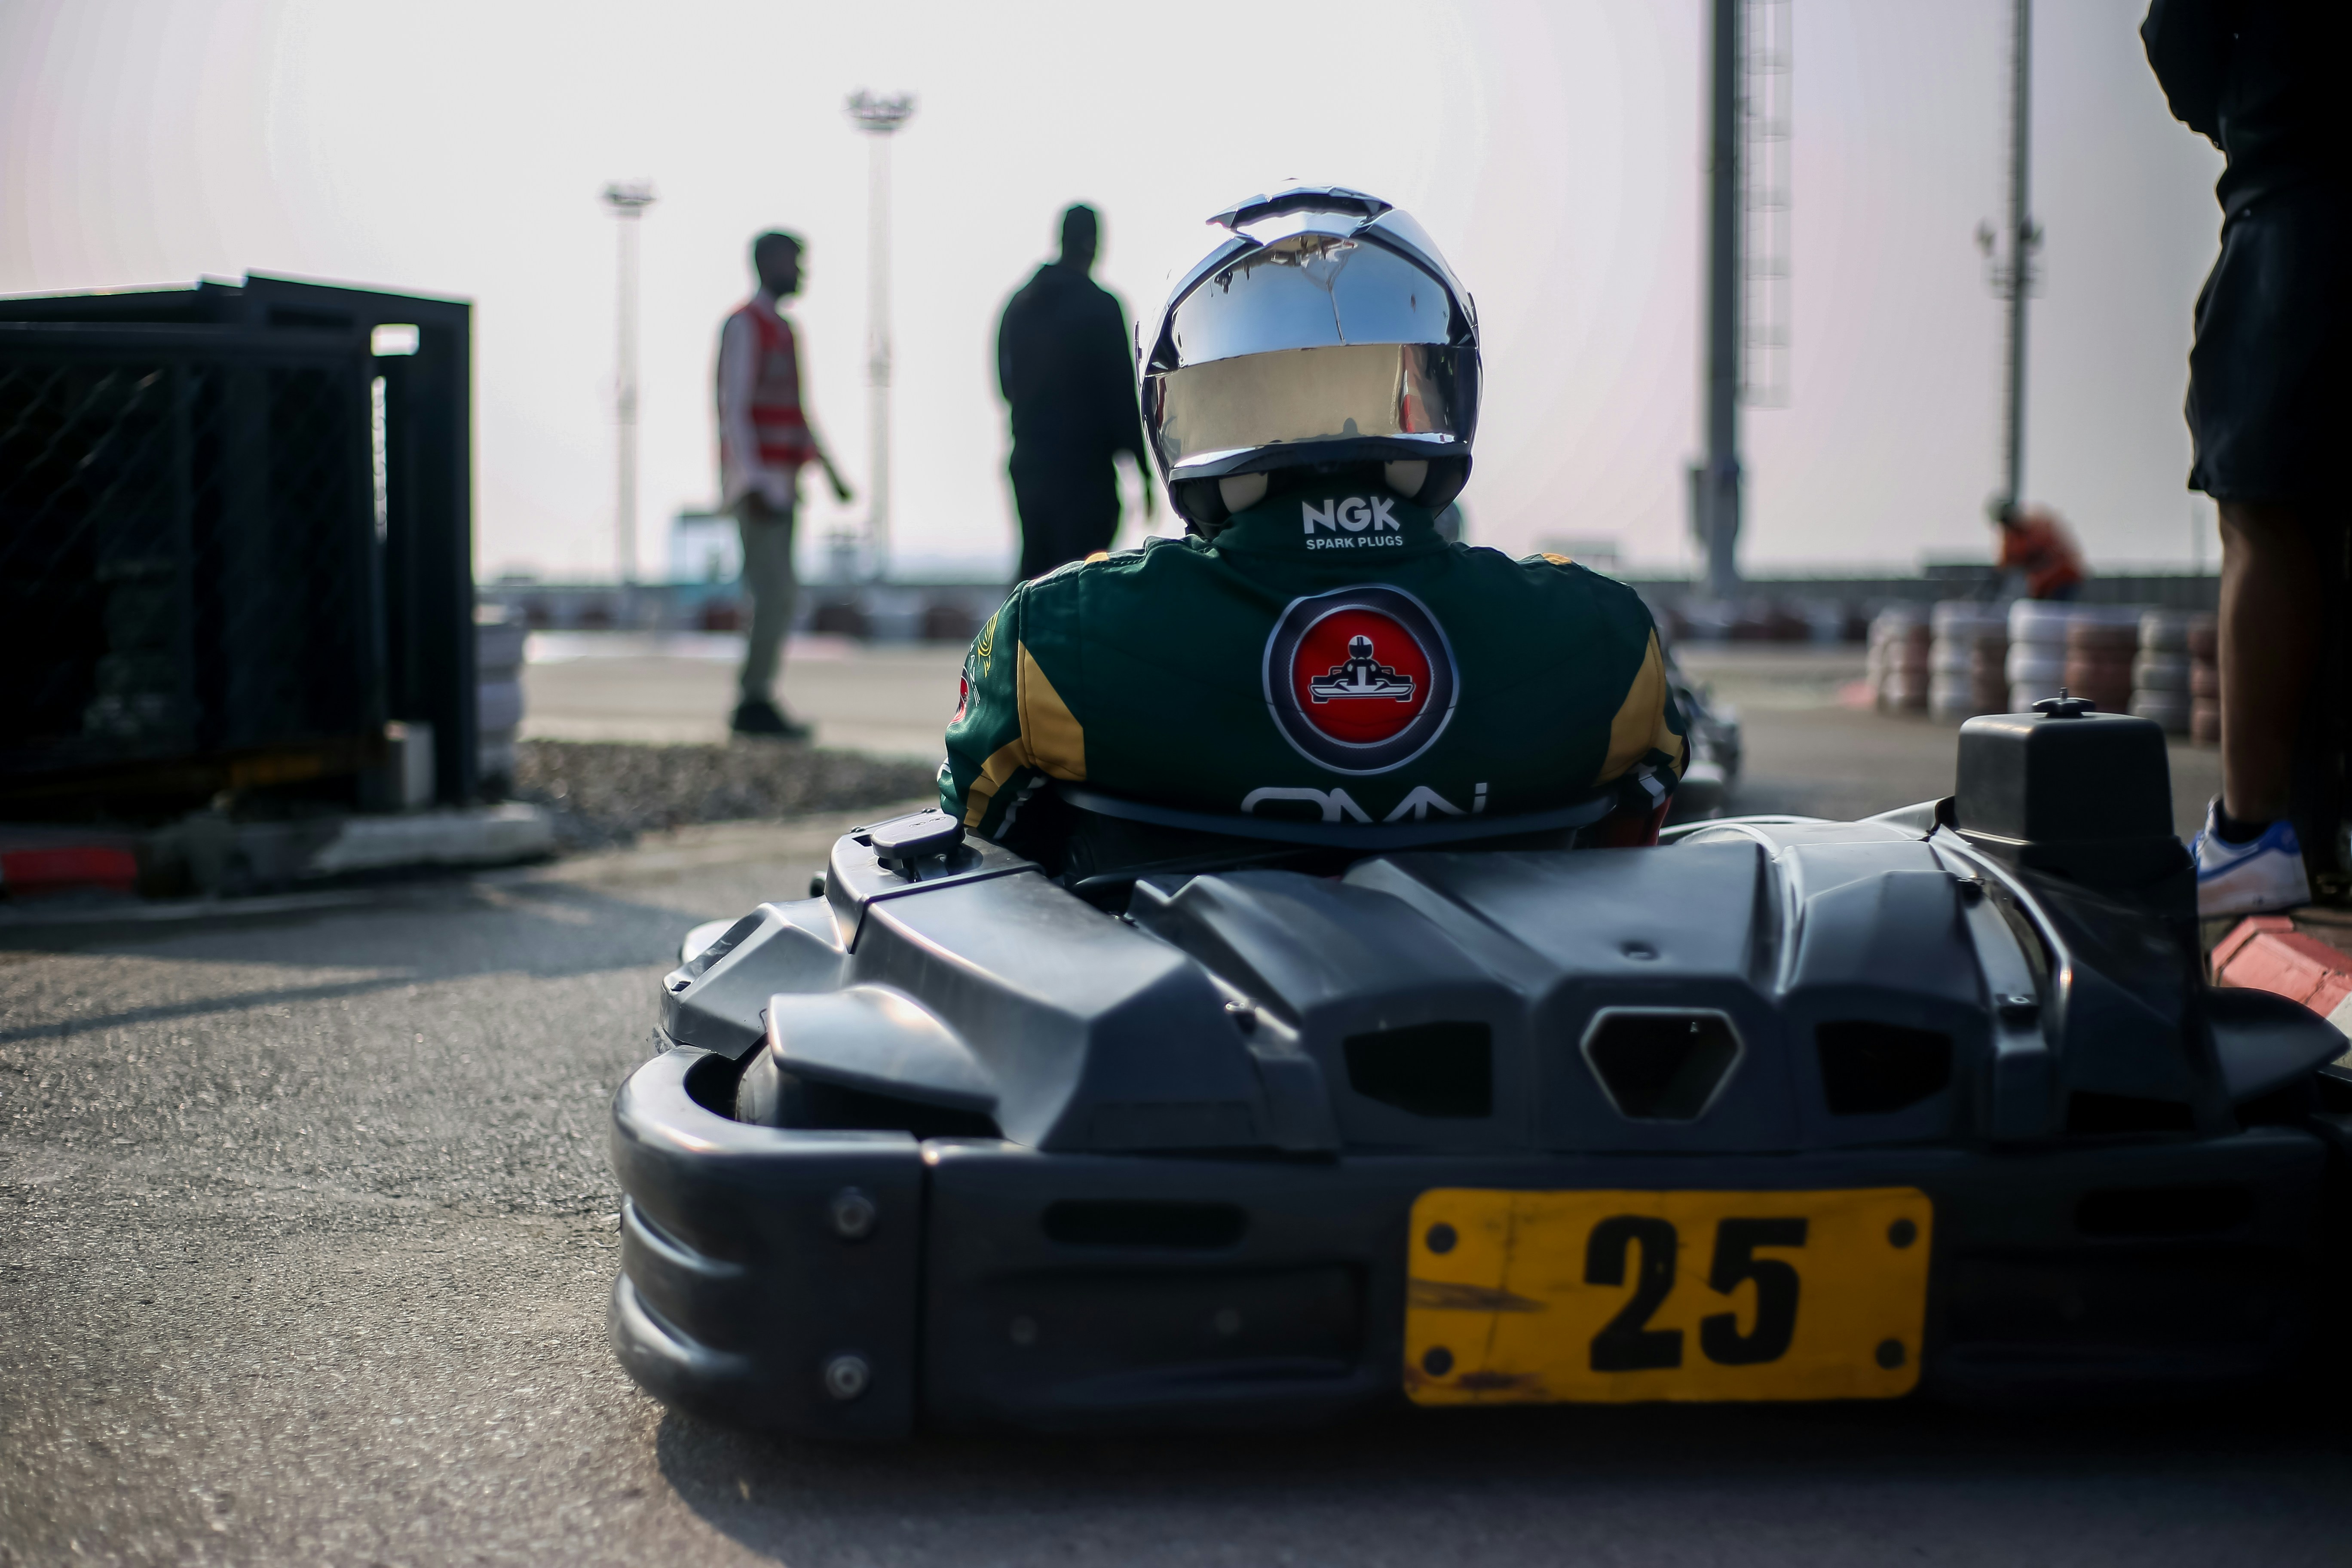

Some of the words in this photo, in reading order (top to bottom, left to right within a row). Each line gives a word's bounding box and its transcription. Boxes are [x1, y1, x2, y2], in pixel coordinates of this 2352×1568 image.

[1302, 496, 1400, 534] NGK
[1306, 538, 1355, 550] SPARK
[1358, 536, 1403, 547] PLUGS
[1583, 1214, 1808, 1373] 25
